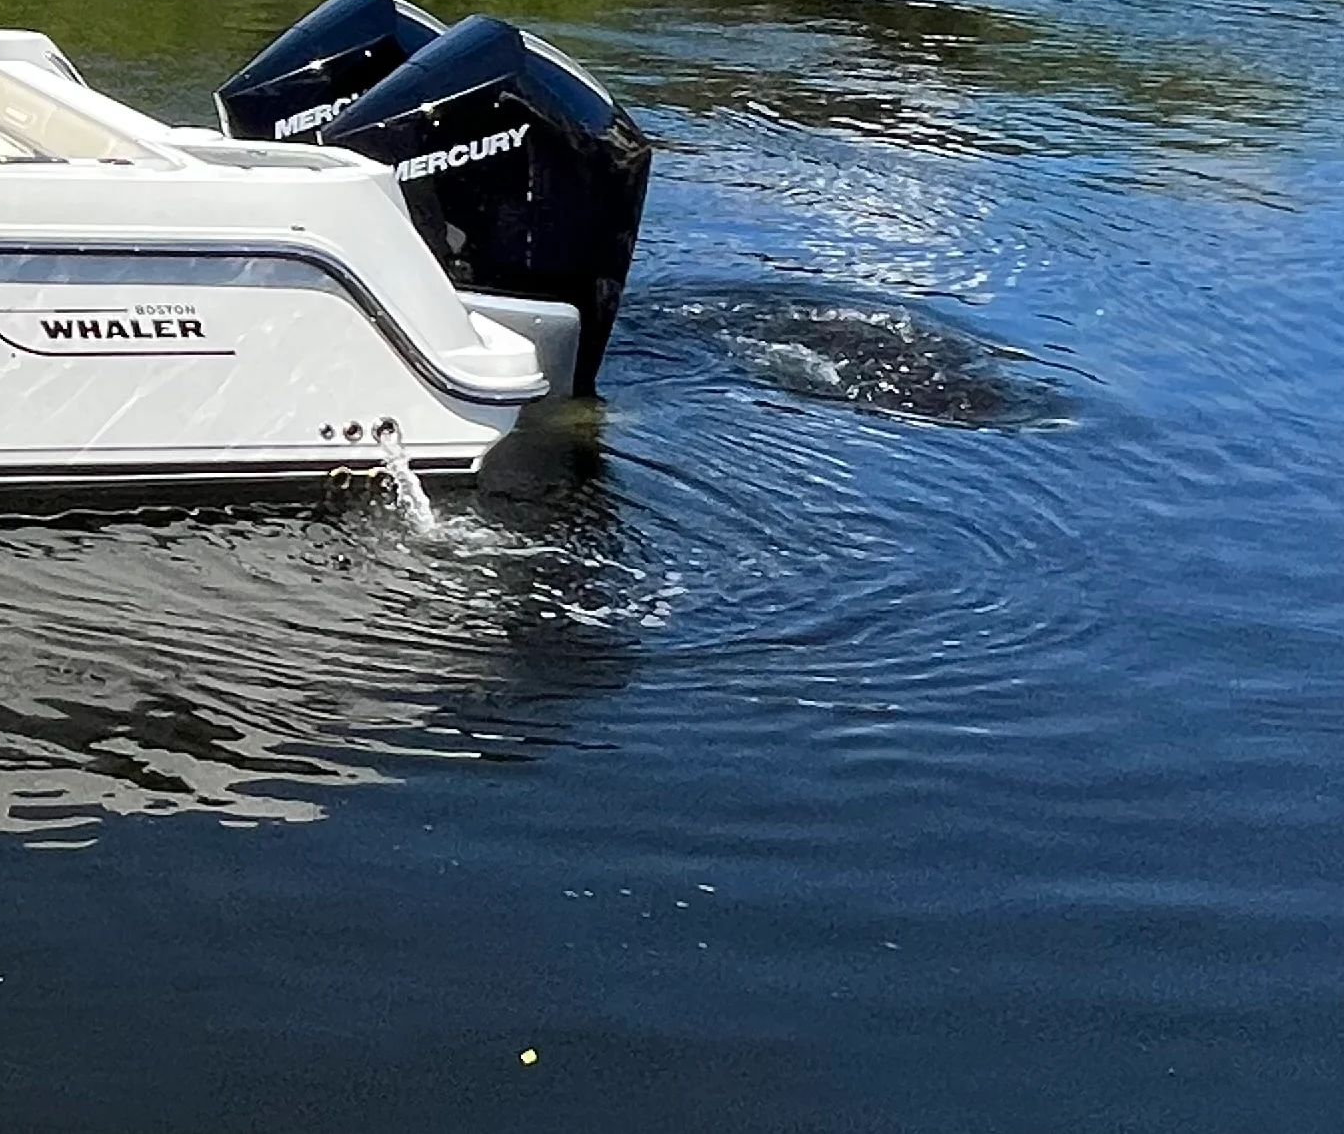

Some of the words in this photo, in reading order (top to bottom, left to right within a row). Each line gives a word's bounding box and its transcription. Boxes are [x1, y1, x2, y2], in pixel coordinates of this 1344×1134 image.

[395, 123, 531, 182] MERCURY
[134, 304, 196, 315] BOSTON
[40, 319, 205, 339] WHALER
